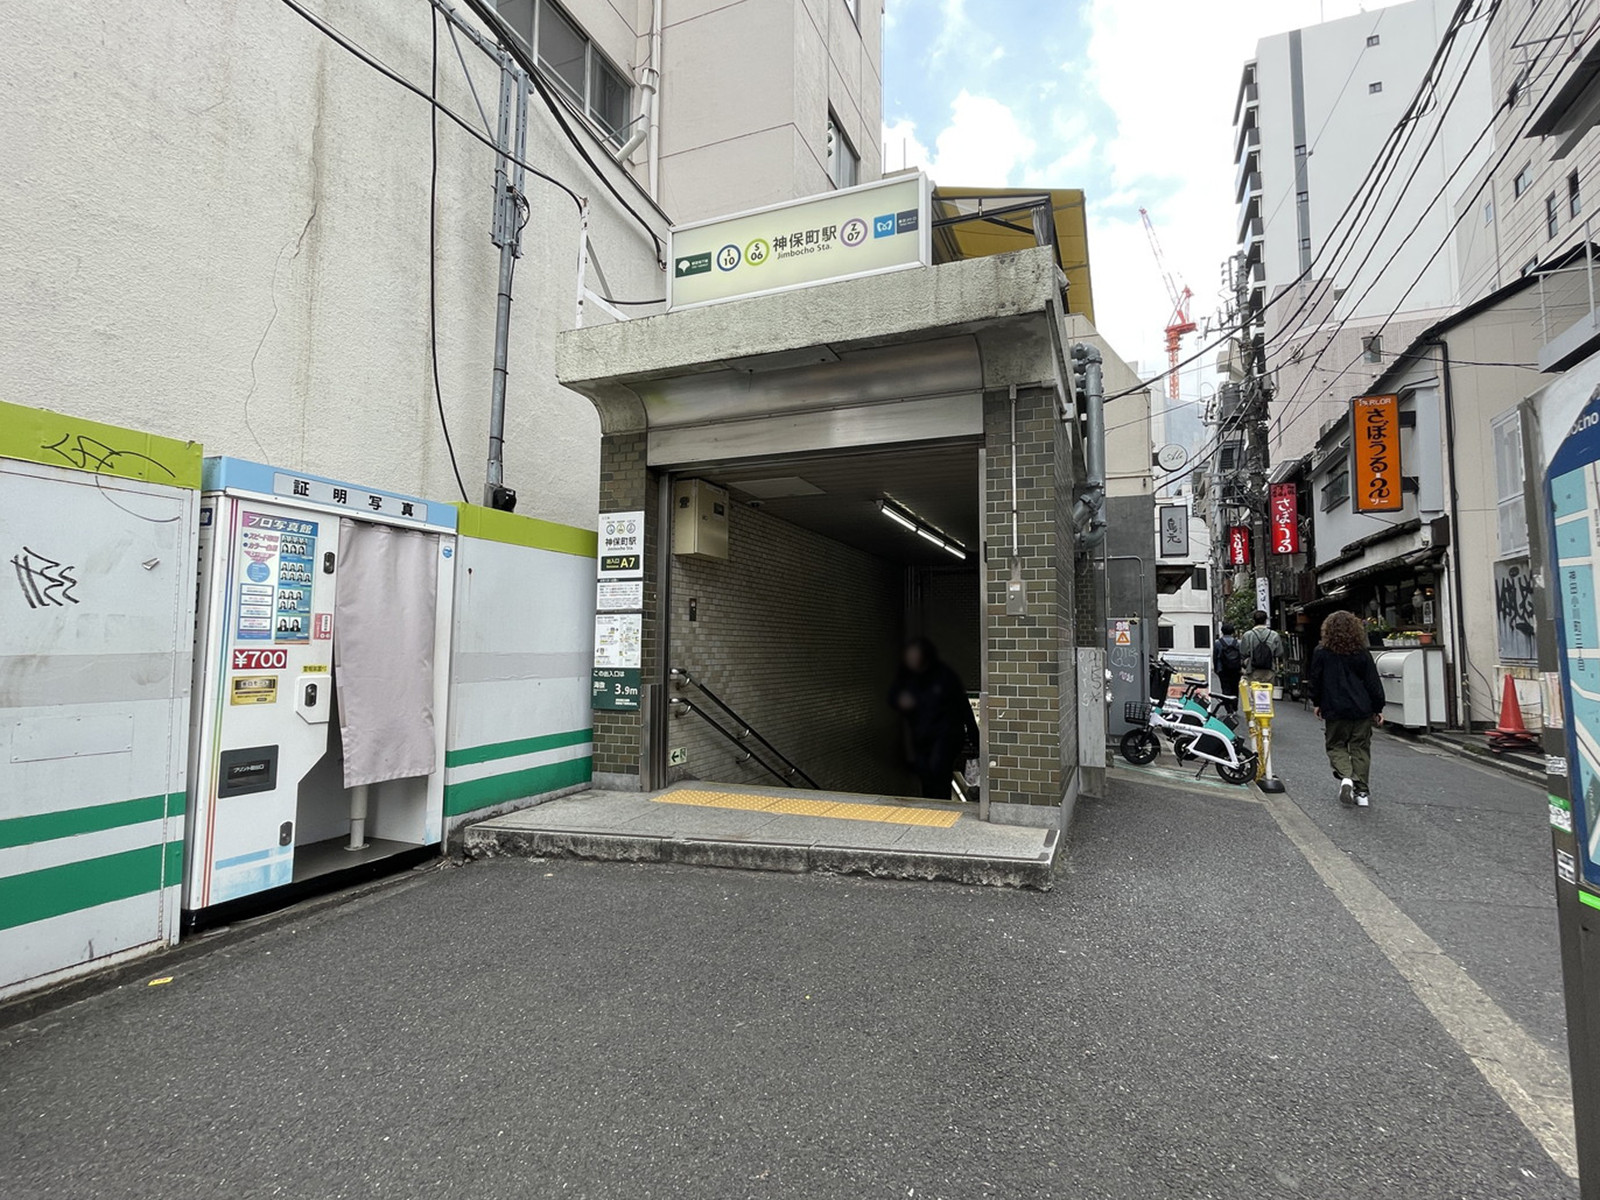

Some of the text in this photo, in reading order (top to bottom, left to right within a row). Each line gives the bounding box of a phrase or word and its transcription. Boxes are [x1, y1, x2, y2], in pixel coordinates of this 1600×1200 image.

[851, 223, 857, 231] Z
[772, 225, 838, 252] 神保町駅
[847, 231, 860, 242] 07
[754, 242, 760, 251] S
[777, 242, 833, 260] Jimbocho Sta.
[724, 257, 735, 266] 10
[750, 251, 763, 261] 06
[293, 479, 414, 517] 証明写真
[248, 515, 313, 534] プロ写真館
[1276, 497, 1294, 554] さぼうる
[605, 537, 637, 547] 神保町駅
[620, 557, 635, 568] A7
[234, 650, 286, 668] ¥700
[614, 683, 638, 695] 3.9m
